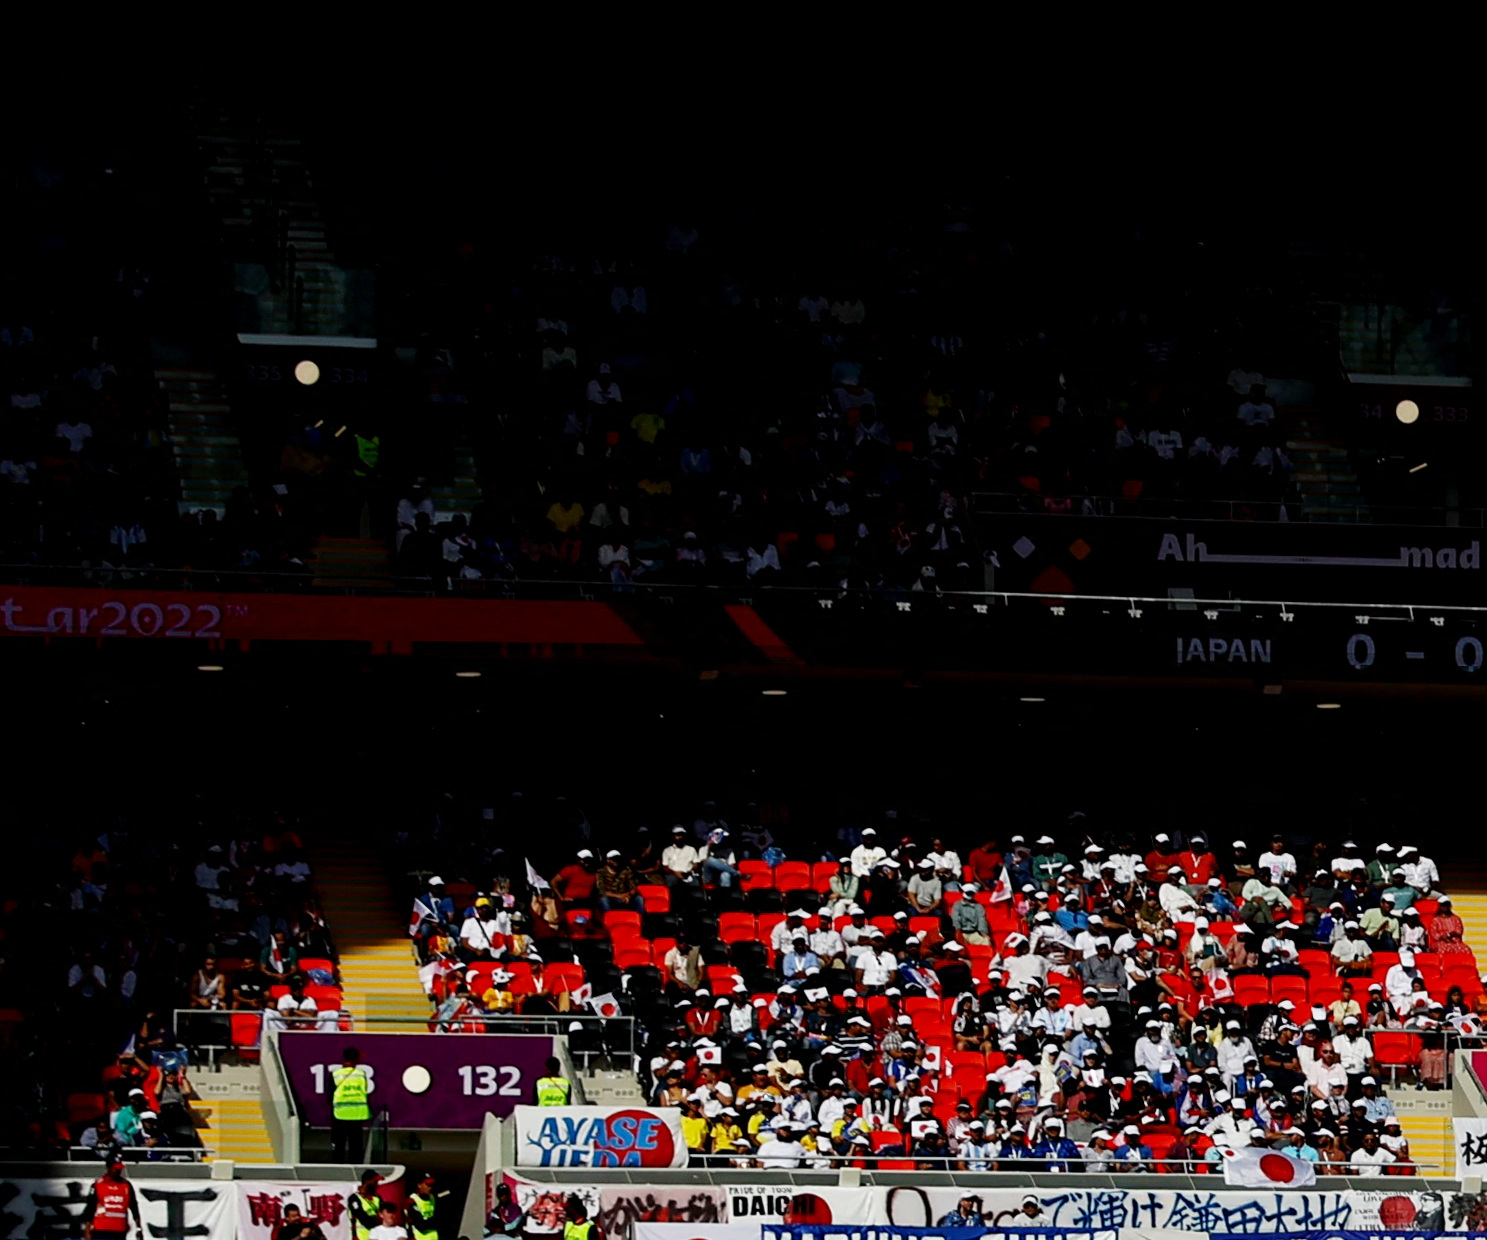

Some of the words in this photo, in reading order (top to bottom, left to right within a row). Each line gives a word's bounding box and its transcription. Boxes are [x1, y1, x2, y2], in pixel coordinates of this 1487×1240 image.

[1176, 636, 1271, 664] JAPAN
[1346, 633, 1376, 669] 0
[1454, 635, 1484, 672] 0
[458, 1065, 522, 1096] 132
[536, 1117, 661, 1150] AYASE
[733, 1195, 815, 1217] DAICHI
